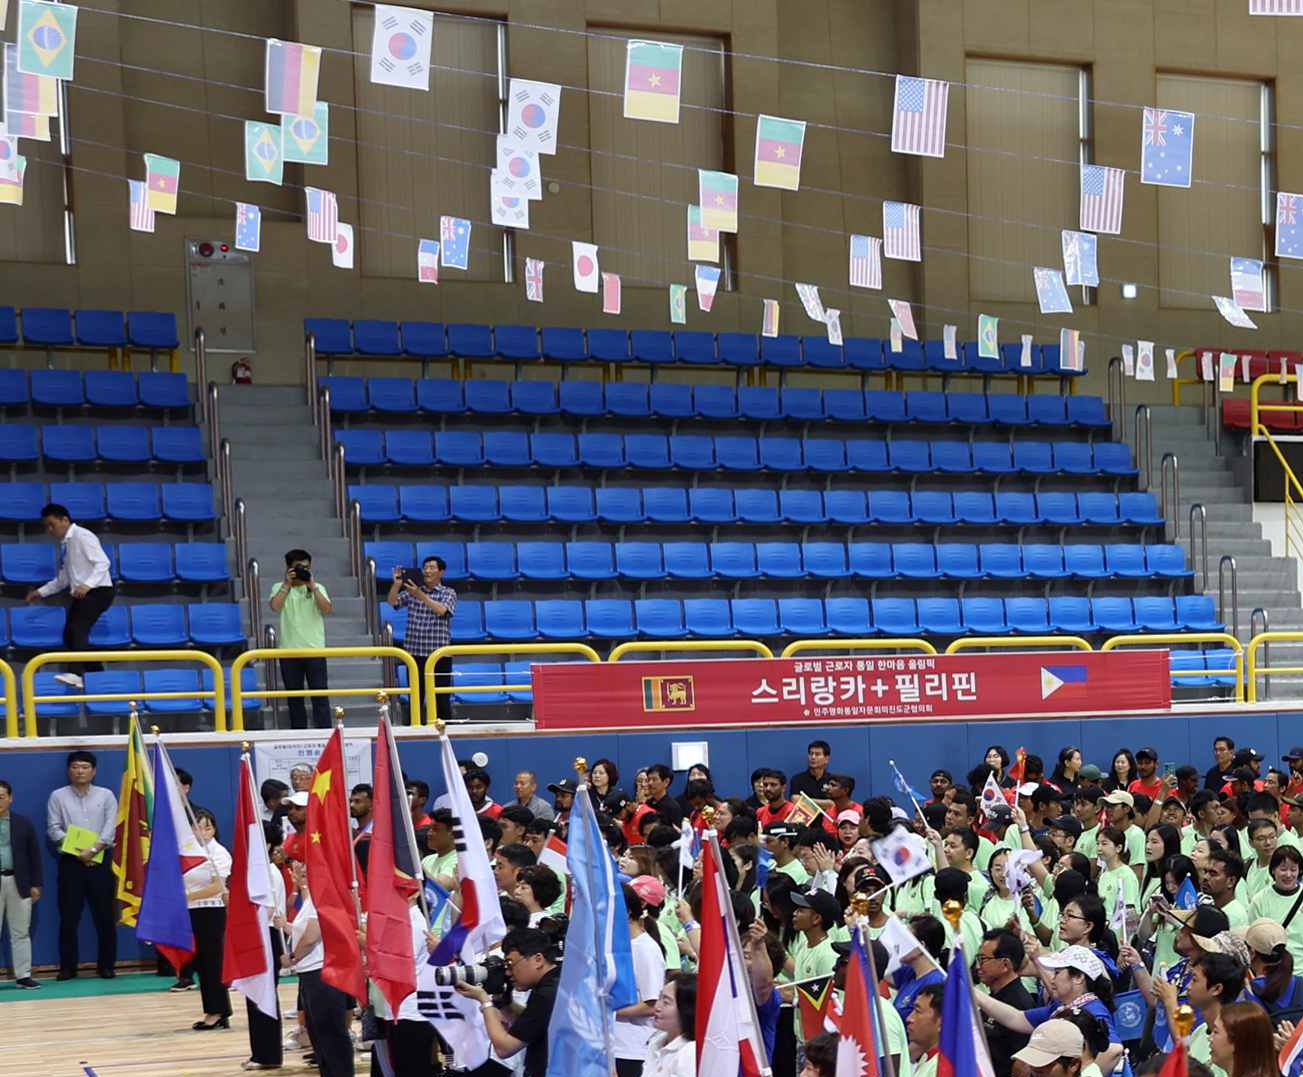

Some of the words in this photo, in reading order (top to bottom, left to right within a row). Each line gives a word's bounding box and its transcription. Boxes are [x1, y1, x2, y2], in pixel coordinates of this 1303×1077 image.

[794, 662, 822, 673] 글로벌
[825, 661, 853, 672] 근로자
[856, 660, 874, 671] 통일
[877, 659, 905, 671] 한마음
[908, 658, 936, 670] 올림픽
